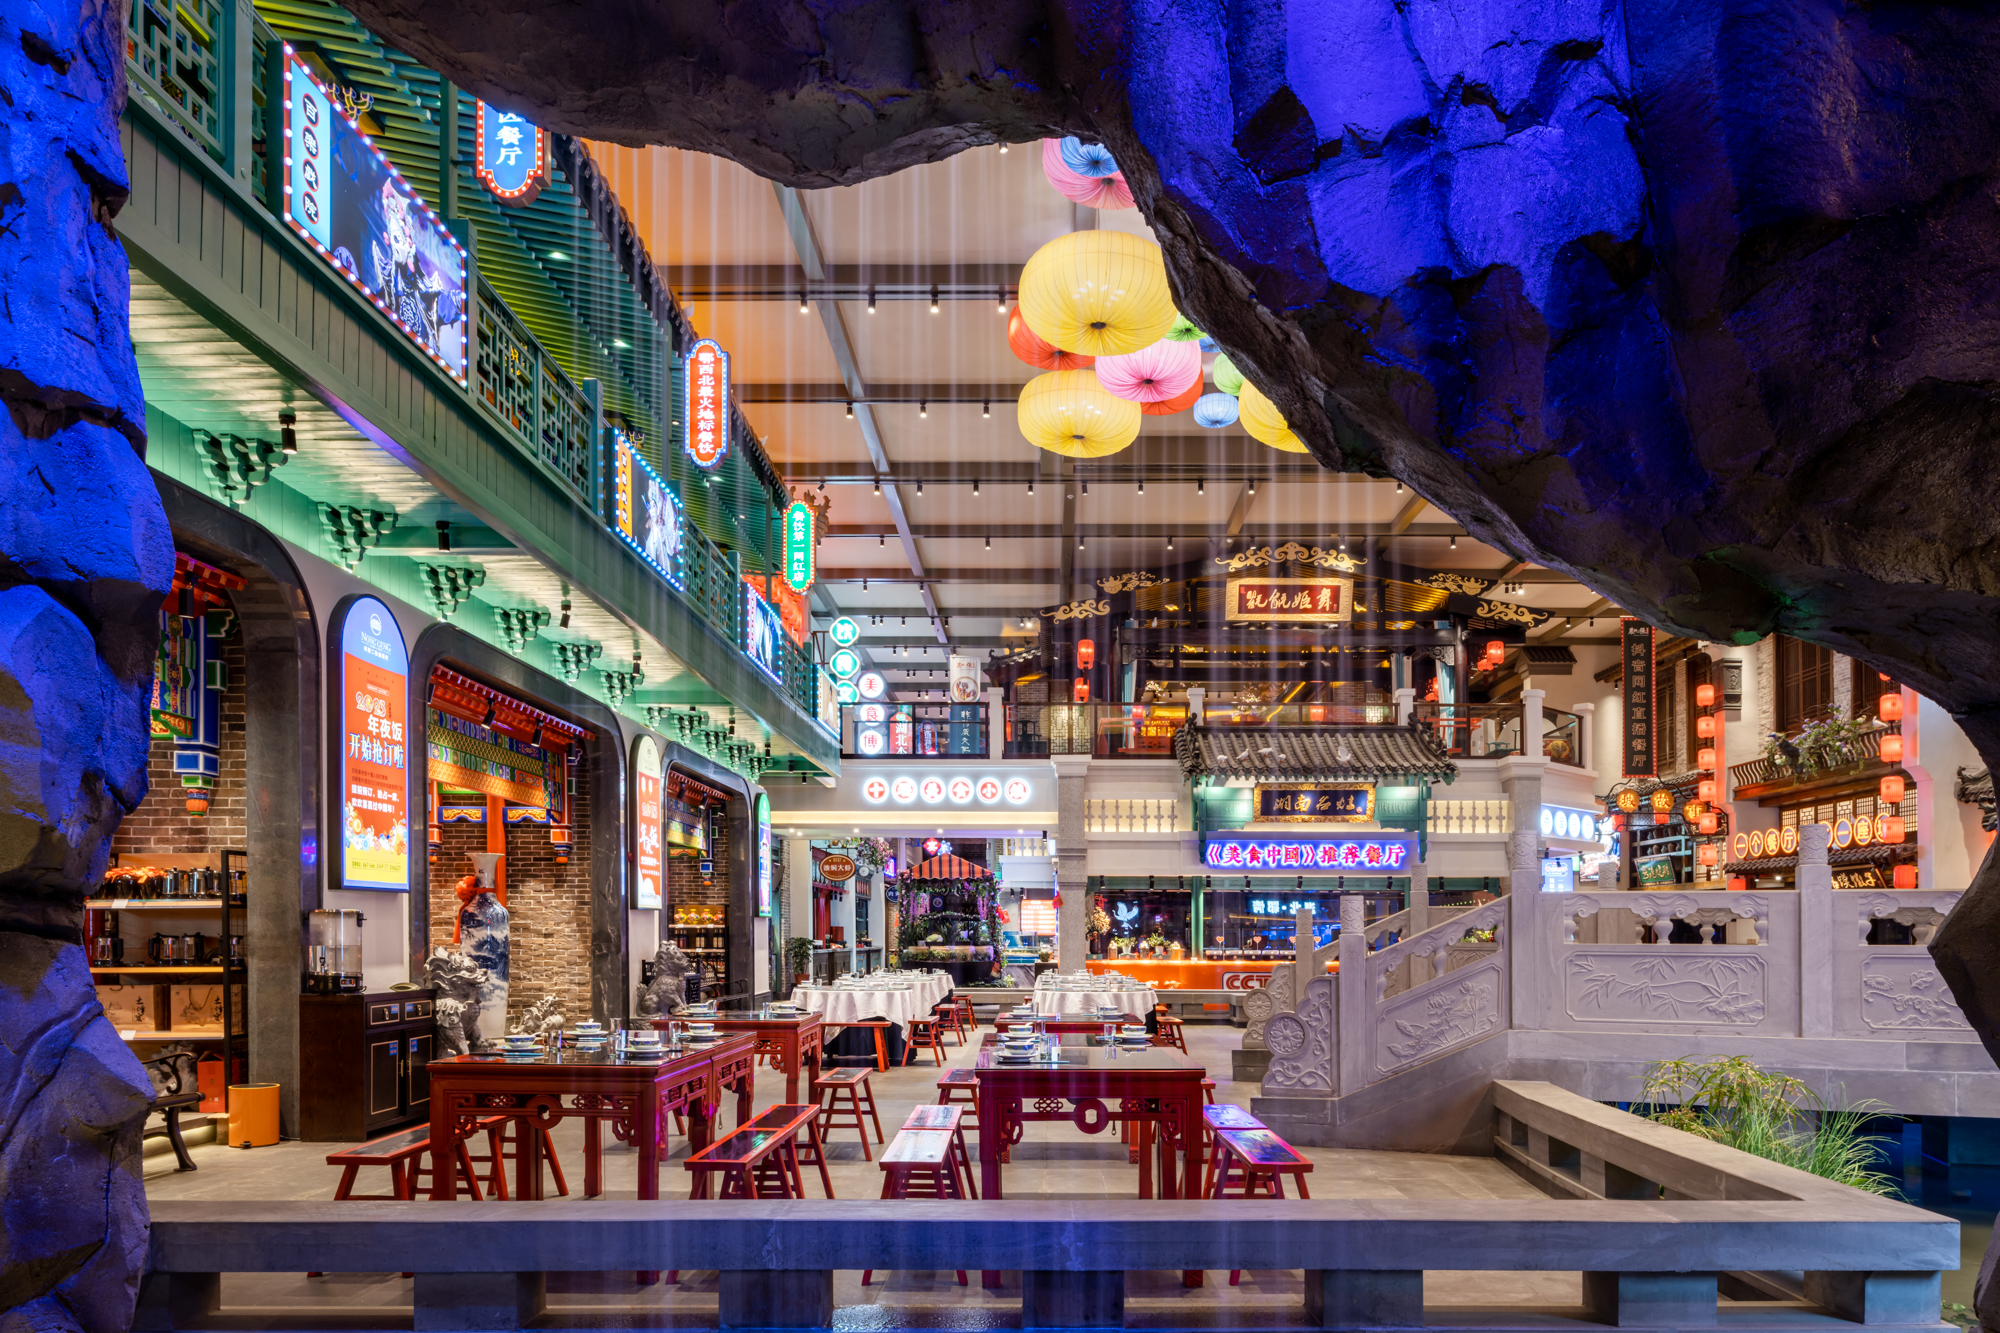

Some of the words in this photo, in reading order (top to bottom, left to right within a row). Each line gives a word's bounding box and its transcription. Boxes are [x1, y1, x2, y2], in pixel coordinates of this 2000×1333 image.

[697, 352, 715, 454] 鄂西北最火地标餐饮
[792, 511, 805, 582] 餐饮第一网红店
[1631, 643, 1647, 767] 抖音网红直播餐厅
[367, 713, 403, 742] 年夜饭
[349, 732, 404, 769] 开始抢订啦
[823, 864, 852, 872] 油焖大虾
[1208, 844, 1405, 866] 《美食中国》推荐餐厅
[1226, 974, 1272, 990] CCT
